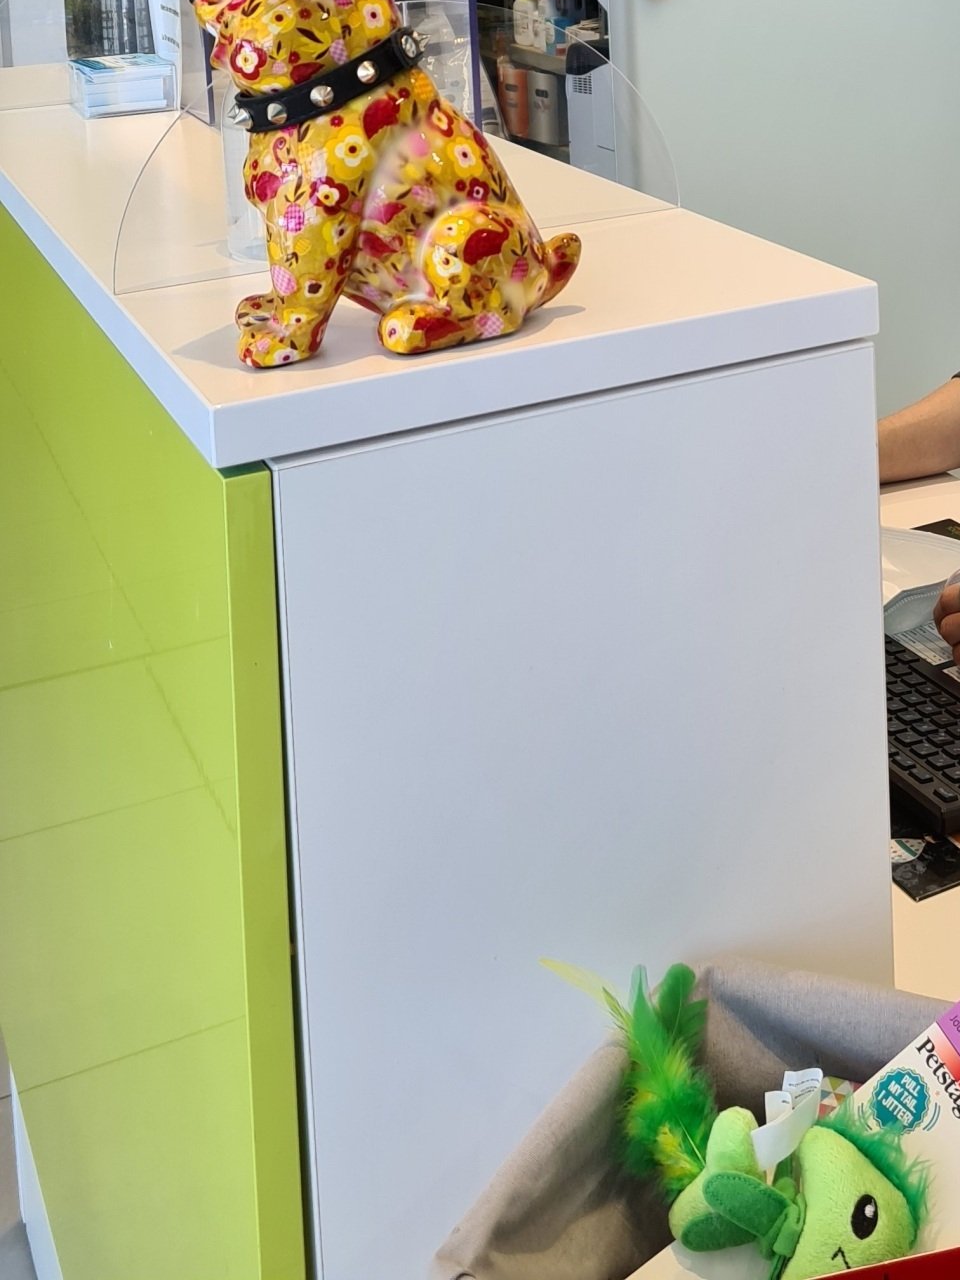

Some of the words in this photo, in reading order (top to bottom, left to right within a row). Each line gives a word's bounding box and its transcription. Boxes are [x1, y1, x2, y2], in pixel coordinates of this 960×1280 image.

[887, 1083, 903, 1098] MY
[900, 1092, 918, 1113] TAIL
[901, 1074, 922, 1097] PULL
[882, 1096, 914, 1127] JITTER!
